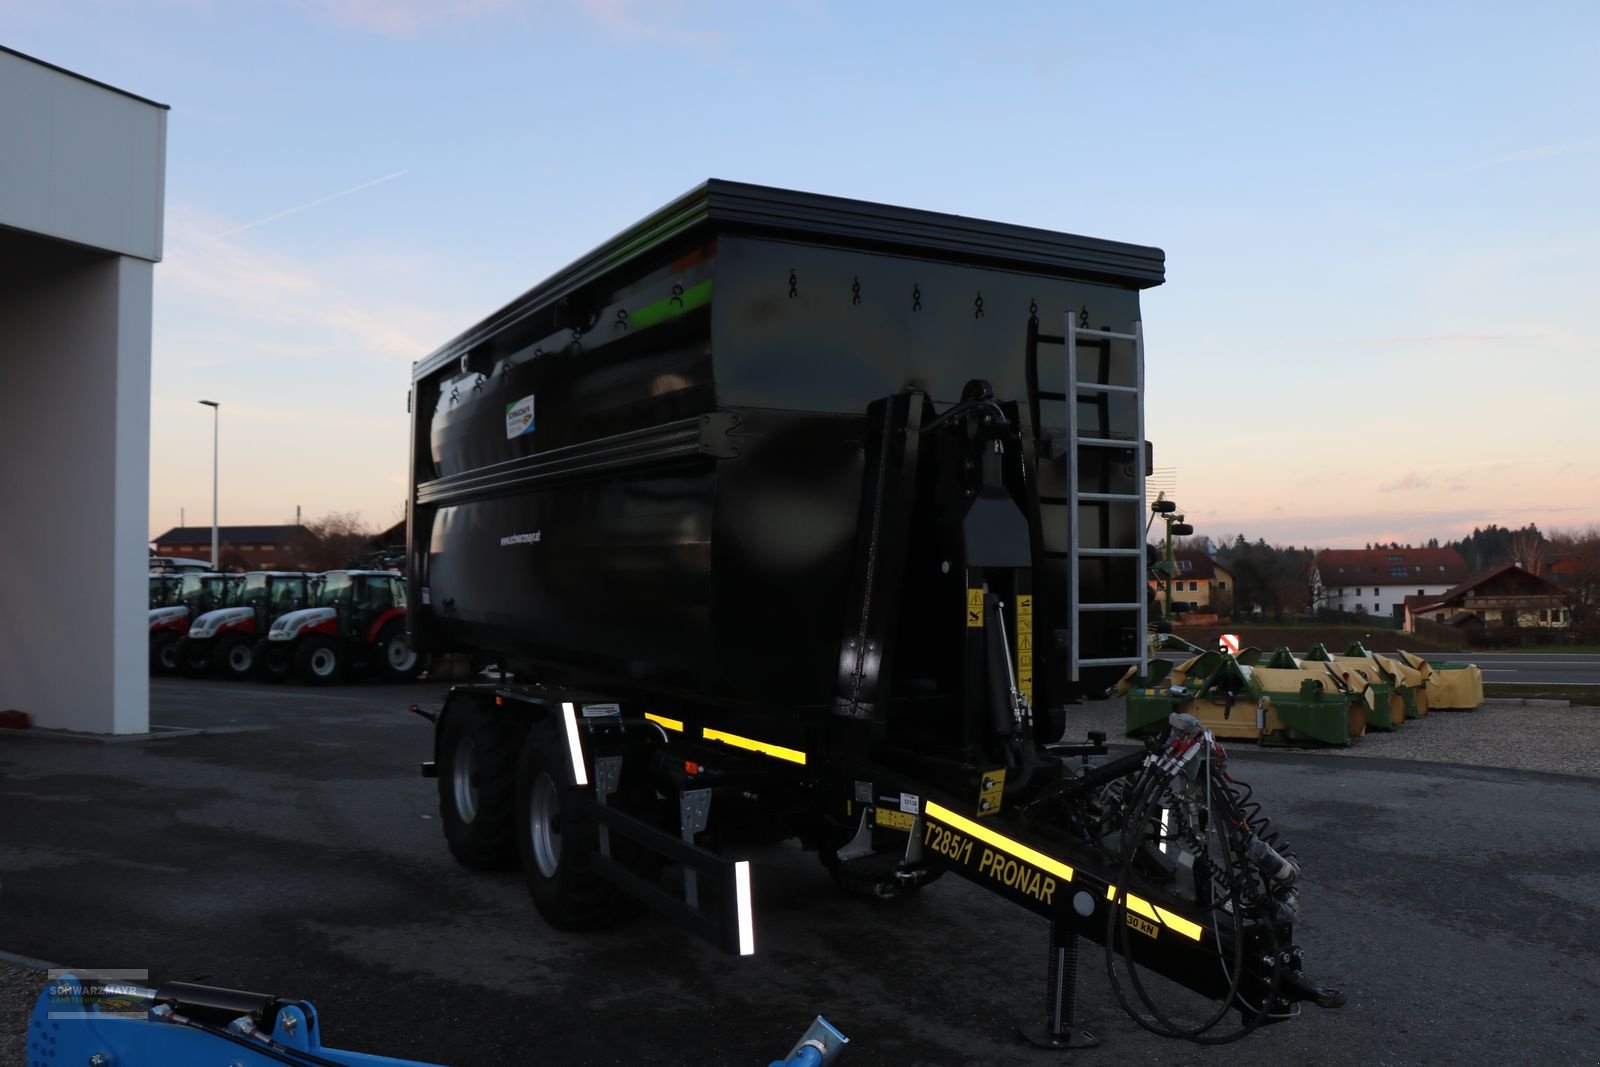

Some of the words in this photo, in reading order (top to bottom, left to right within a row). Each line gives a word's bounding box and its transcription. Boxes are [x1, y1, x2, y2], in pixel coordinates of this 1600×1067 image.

[924, 821, 973, 865] T285/1
[978, 848, 1056, 905] PRONAR
[1127, 914, 1138, 927] 30
[1140, 921, 1154, 935] kN
